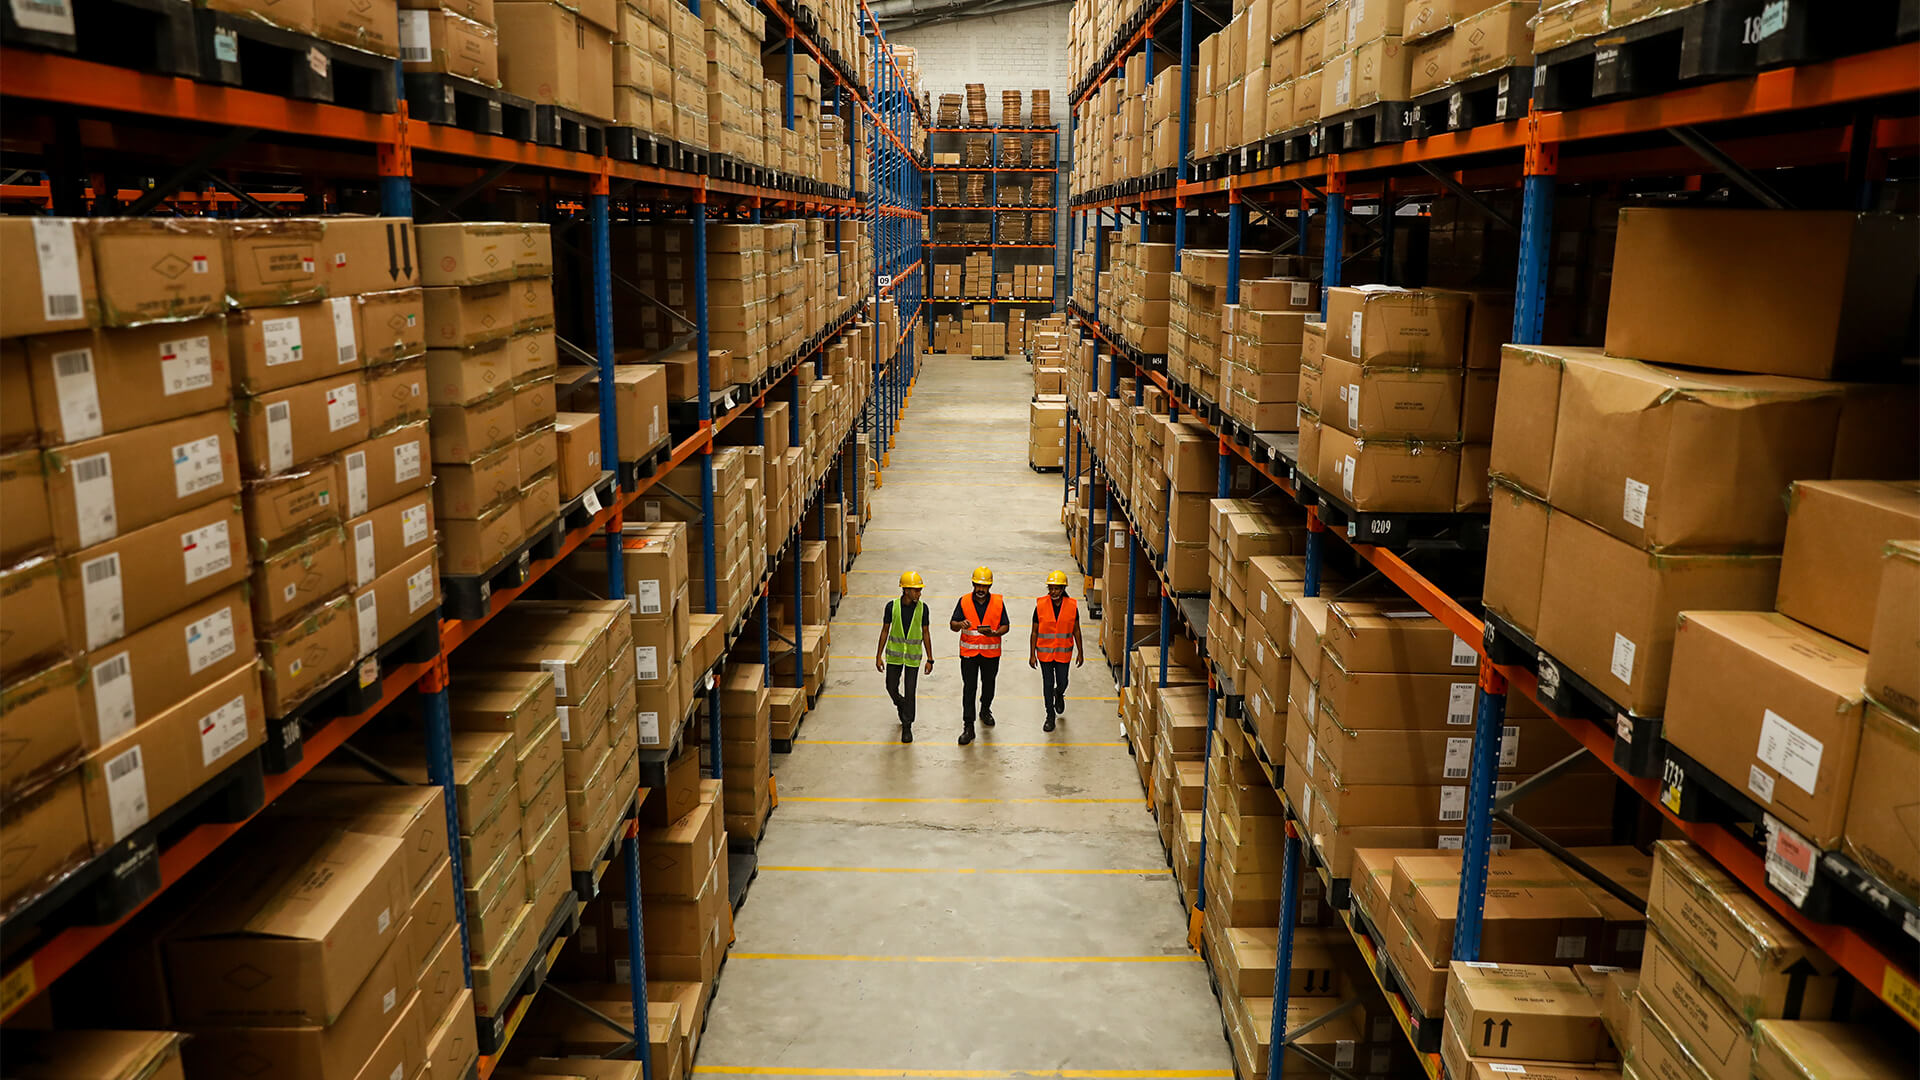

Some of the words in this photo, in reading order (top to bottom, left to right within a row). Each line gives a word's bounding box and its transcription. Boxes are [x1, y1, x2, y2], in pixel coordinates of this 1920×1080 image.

[879, 277, 889, 285] 09
[1371, 519, 1391, 534] 0209
[1663, 758, 1685, 792] 1732
